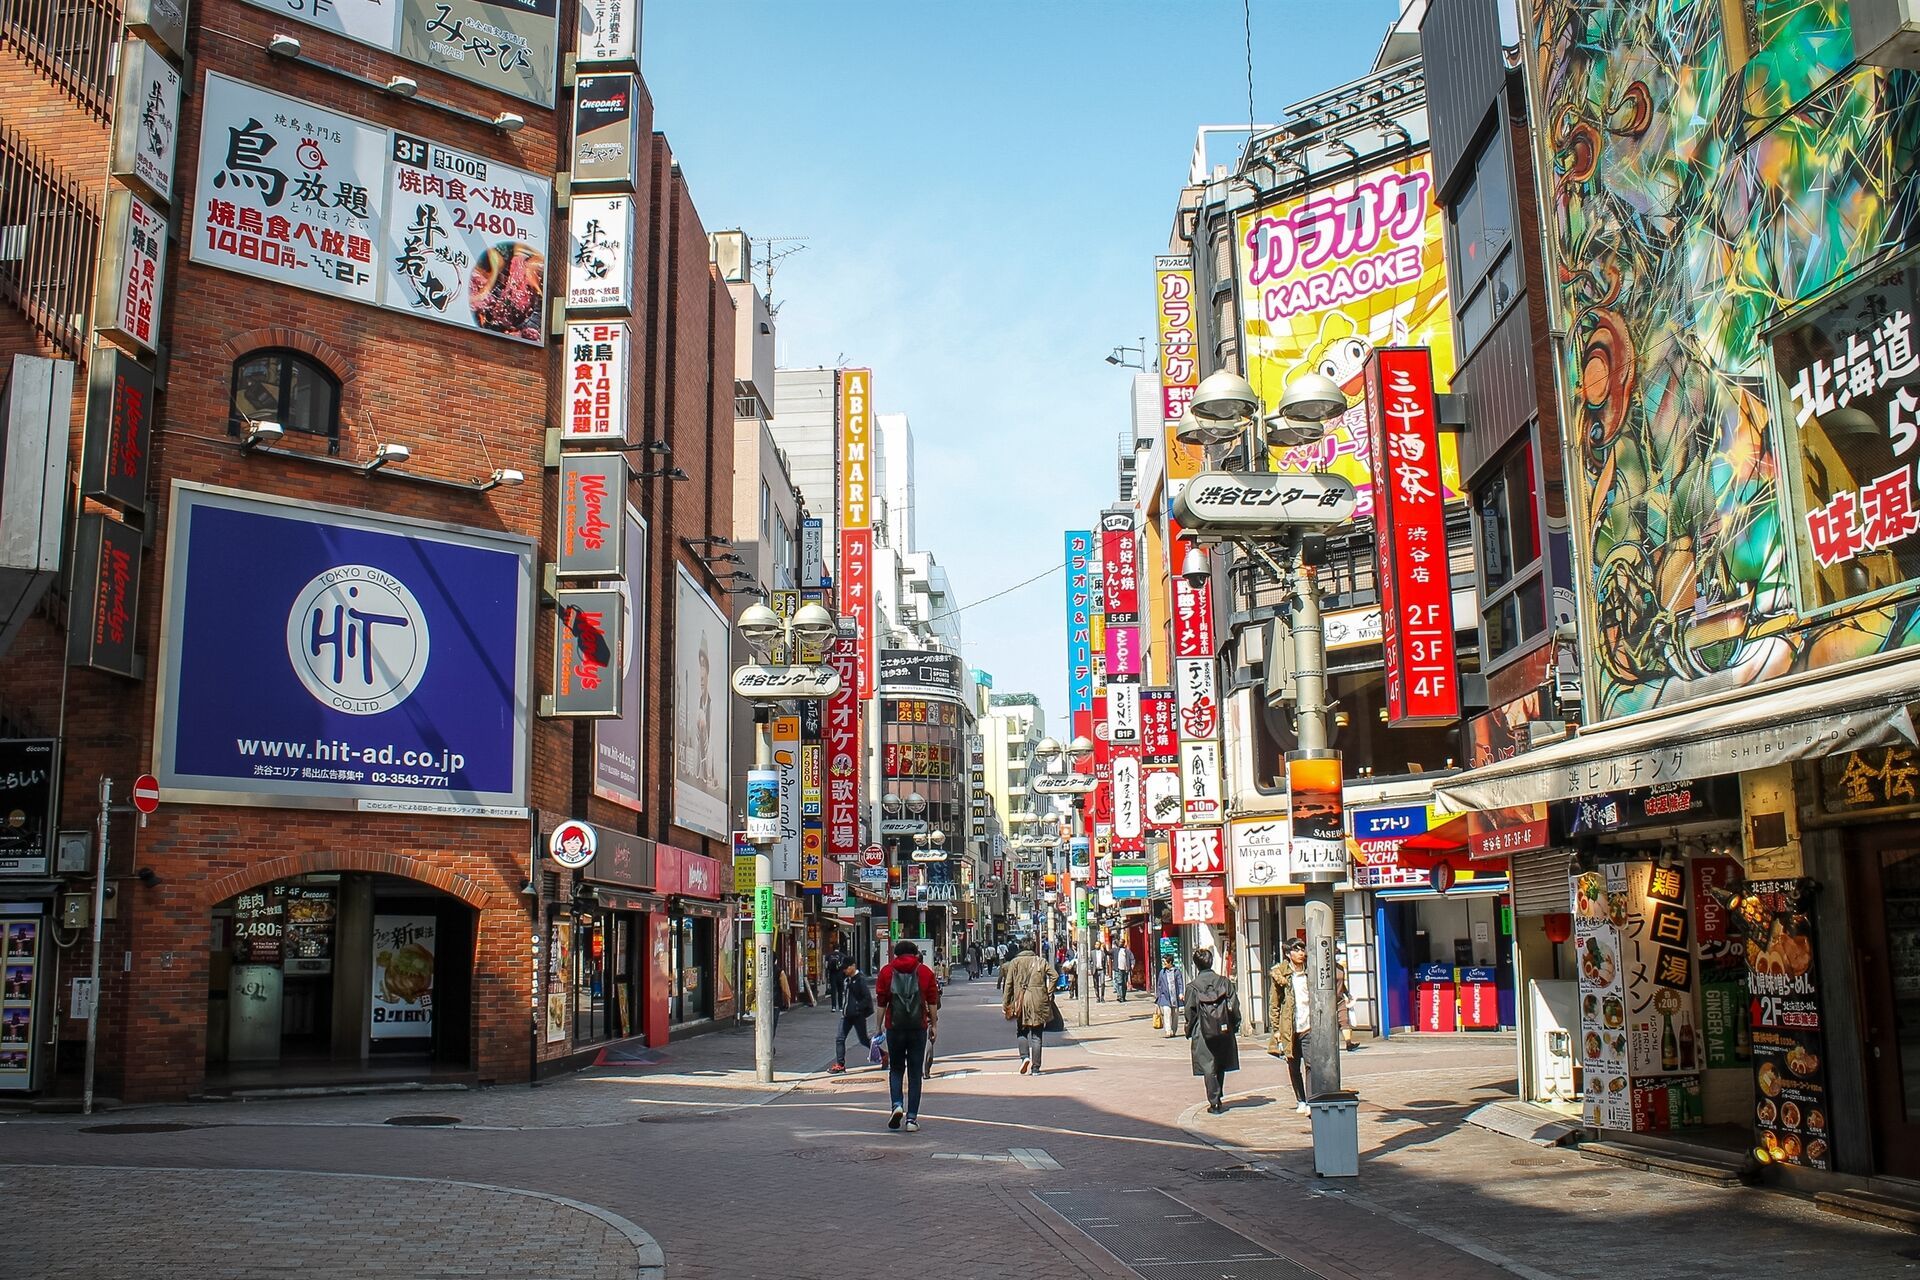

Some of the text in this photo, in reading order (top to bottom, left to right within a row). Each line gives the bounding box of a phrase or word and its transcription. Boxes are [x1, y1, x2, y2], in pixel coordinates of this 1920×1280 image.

[426, 2, 533, 72] みやび
[594, 0, 605, 48] ニタールーム
[609, 0, 620, 44] 谷消費者
[429, 40, 464, 61] MIYABI
[168, 71, 177, 85] 3F
[579, 79, 593, 88] 4F
[274, 113, 341, 143] 焼鳥専門店
[397, 140, 424, 162] 3F
[398, 169, 534, 215] 焼肉食べ放題
[609, 202, 621, 210] 3F
[133, 202, 150, 227] 2F
[290, 201, 369, 230] とりほうだい
[1247, 171, 1430, 286] カラオケ
[132, 227, 158, 262] 焼鳥
[208, 198, 371, 263] 焼鳥食べ放題
[335, 261, 369, 285] 2F
[1159, 259, 1190, 267] プリンスビル
[124, 252, 140, 331] 1480円
[1265, 245, 1422, 322] KARAOKE
[137, 259, 155, 342] 食べ放題
[594, 327, 620, 341] 2F
[1162, 274, 1194, 382] カラオケ
[574, 344, 612, 362] 焼鳥
[1790, 310, 1920, 429] 北海道
[573, 363, 592, 433] 食べ放題
[595, 363, 610, 432] 1480円
[1168, 387, 1195, 401] 受付
[1386, 369, 1436, 505] 三平酒寮
[577, 475, 611, 550] Wendy's
[1195, 487, 1346, 508] 渋谷センター街
[565, 472, 577, 556] First Kitchen
[805, 531, 813, 580] モニタールーム
[1119, 537, 1135, 590] お好み焼
[1407, 527, 1431, 583] 渋谷店
[318, 567, 403, 595] TOKYO GINZA
[1106, 562, 1121, 609] もんじゃ
[1367, 619, 1382, 627] Caf
[1384, 610, 1394, 635] 2F
[1408, 604, 1440, 626] 2F
[1358, 629, 1382, 638] Miya
[1387, 645, 1397, 670] 3F
[1411, 640, 1442, 662] 3F
[561, 642, 573, 696] Kitchen
[739, 672, 833, 686] 渋谷センター街
[1390, 677, 1399, 703] 4F
[1413, 676, 1446, 698] 4F
[831, 657, 854, 751] カラオケ
[777, 724, 793, 733] B1
[1117, 730, 1132, 738] B1F
[1143, 714, 1155, 754] もんじゃ
[1156, 701, 1169, 746] お好み焼
[237, 738, 465, 773] www.hit-ad.co.jp
[253, 764, 449, 787] 渋谷エリア 掲出広告募集中 03-3543-7771
[1038, 778, 1094, 788] 渋谷センター街
[1192, 746, 1207, 797] 一風堂
[832, 780, 854, 848] 歌広場
[1370, 816, 1410, 831] エアトリ
[1175, 830, 1220, 873] 豚
[1239, 847, 1283, 857] Miyama
[1248, 834, 1271, 845] Cafe
[806, 855, 819, 882] 松屋
[1298, 848, 1344, 863] 九十九島
[238, 894, 264, 909] 焼肉
[274, 887, 285, 895] 3F
[1183, 878, 1214, 922] 野郎
[1651, 867, 1688, 985] 鶏白湯
[1627, 912, 1653, 1015] ラーメン
[1430, 983, 1441, 1030] Exchange
[1472, 983, 1481, 1024] Exchange
[1705, 989, 1724, 1036] GINGER
[1760, 996, 1782, 1026] 2F
[1708, 1036, 1725, 1062] ALE
